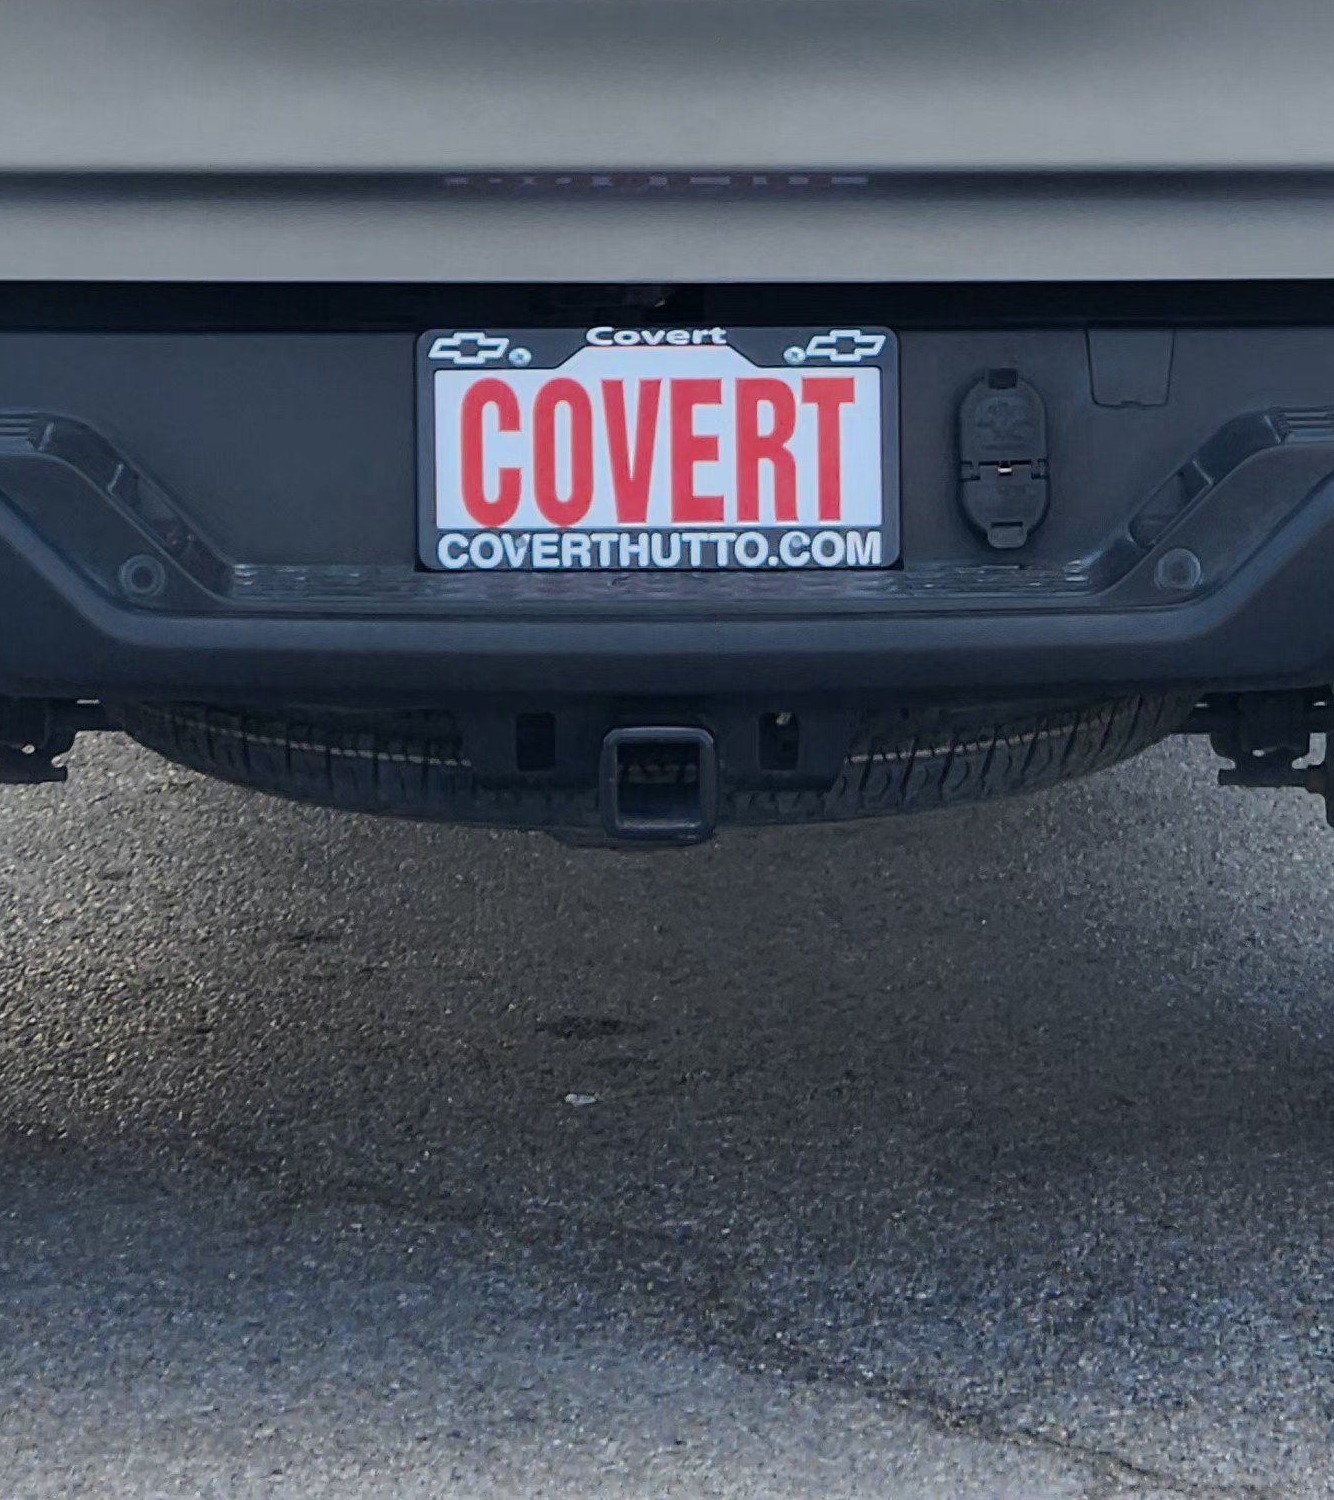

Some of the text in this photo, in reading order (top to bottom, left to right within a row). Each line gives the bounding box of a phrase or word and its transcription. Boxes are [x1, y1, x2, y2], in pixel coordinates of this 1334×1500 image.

[585, 326, 728, 346] Covert
[460, 376, 856, 528] COVERT
[437, 530, 882, 568] COVERTHUTTO.COM
